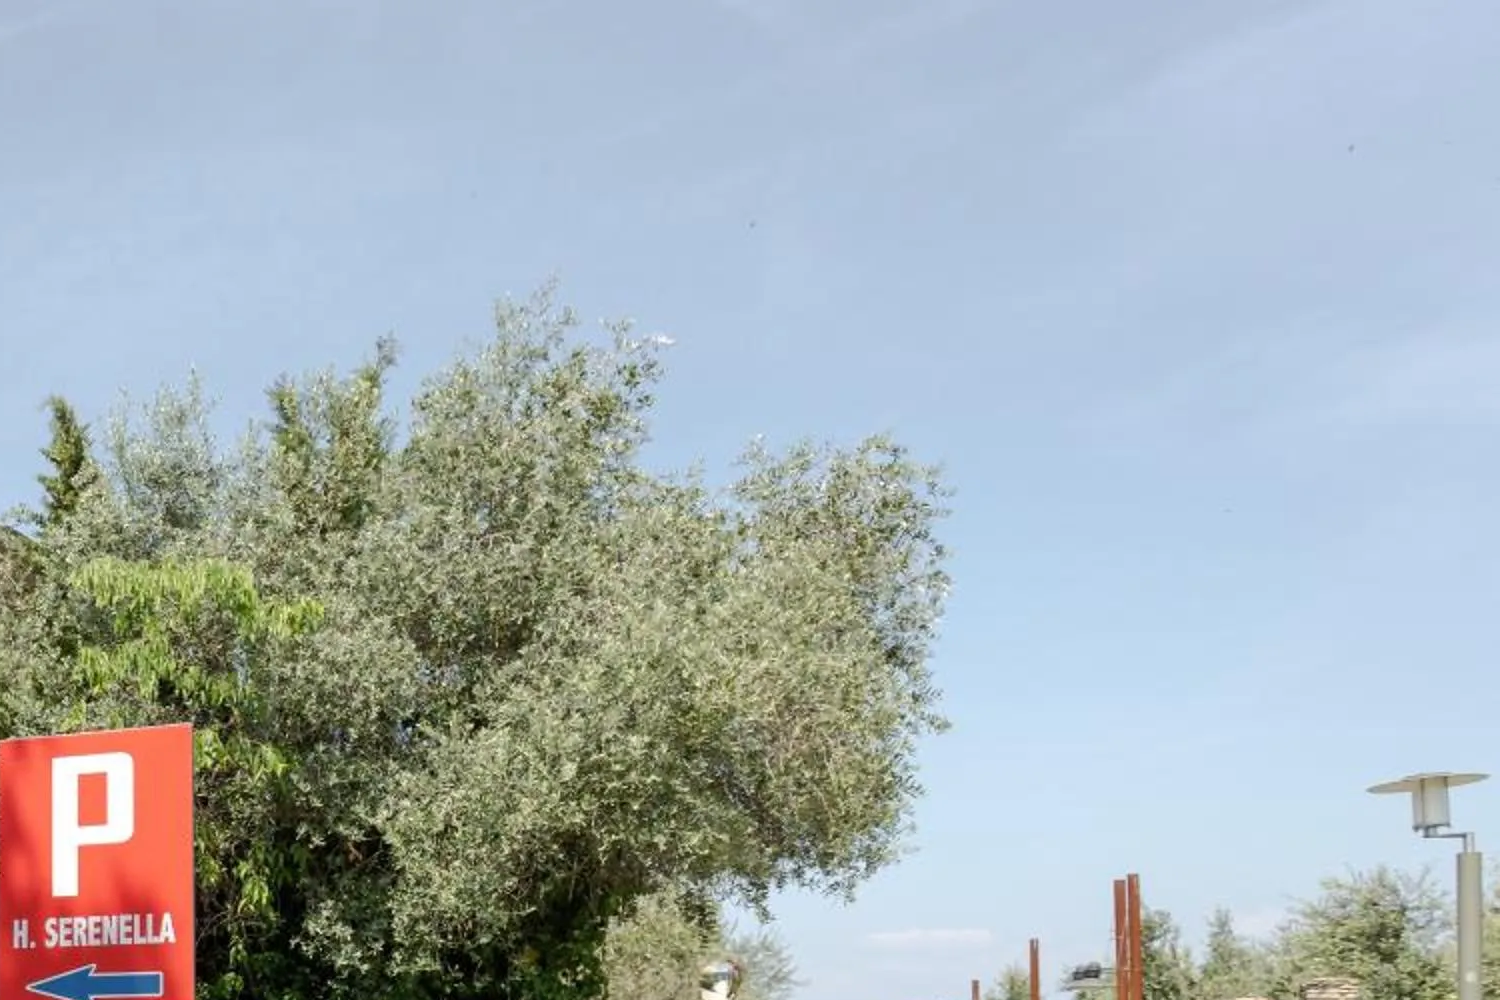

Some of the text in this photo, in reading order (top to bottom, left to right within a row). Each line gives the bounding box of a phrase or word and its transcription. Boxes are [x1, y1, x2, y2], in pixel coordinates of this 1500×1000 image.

[51, 751, 135, 898] P
[12, 912, 176, 949] H. SERENELLA
